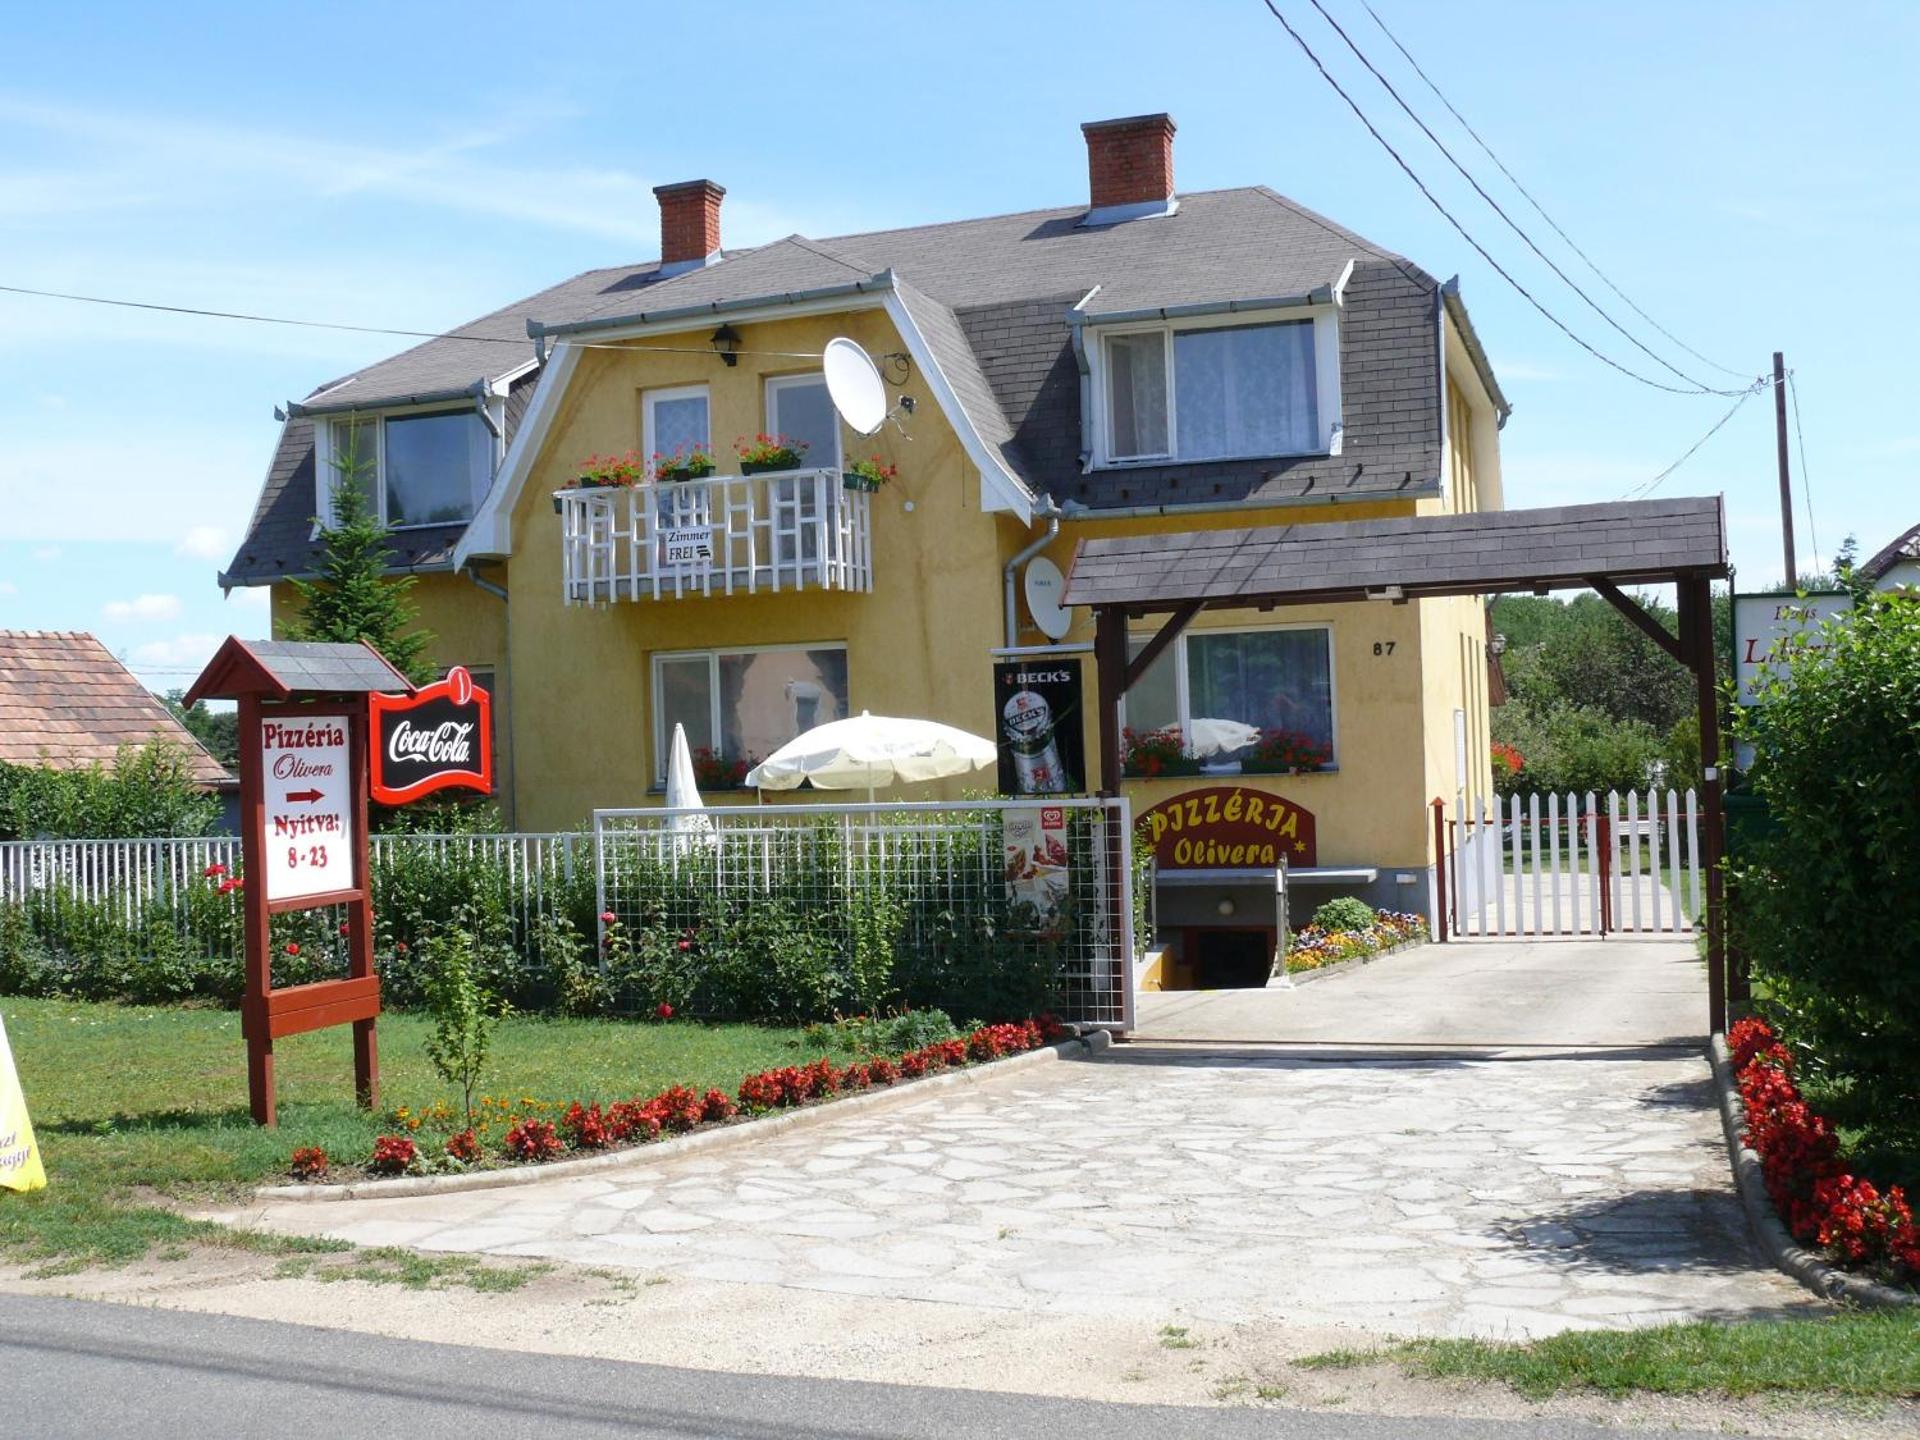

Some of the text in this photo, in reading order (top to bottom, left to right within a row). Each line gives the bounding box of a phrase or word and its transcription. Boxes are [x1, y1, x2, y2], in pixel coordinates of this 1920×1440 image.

[668, 530, 711, 542] Zimmer
[669, 546, 693, 560] FREI
[1373, 641, 1396, 656] 87
[1017, 669, 1071, 683] BECK'S
[264, 723, 344, 750] Pizzéria
[389, 720, 474, 762] Coca-Cola
[273, 753, 333, 780] Olivera
[1174, 837, 1274, 865] Olivera
